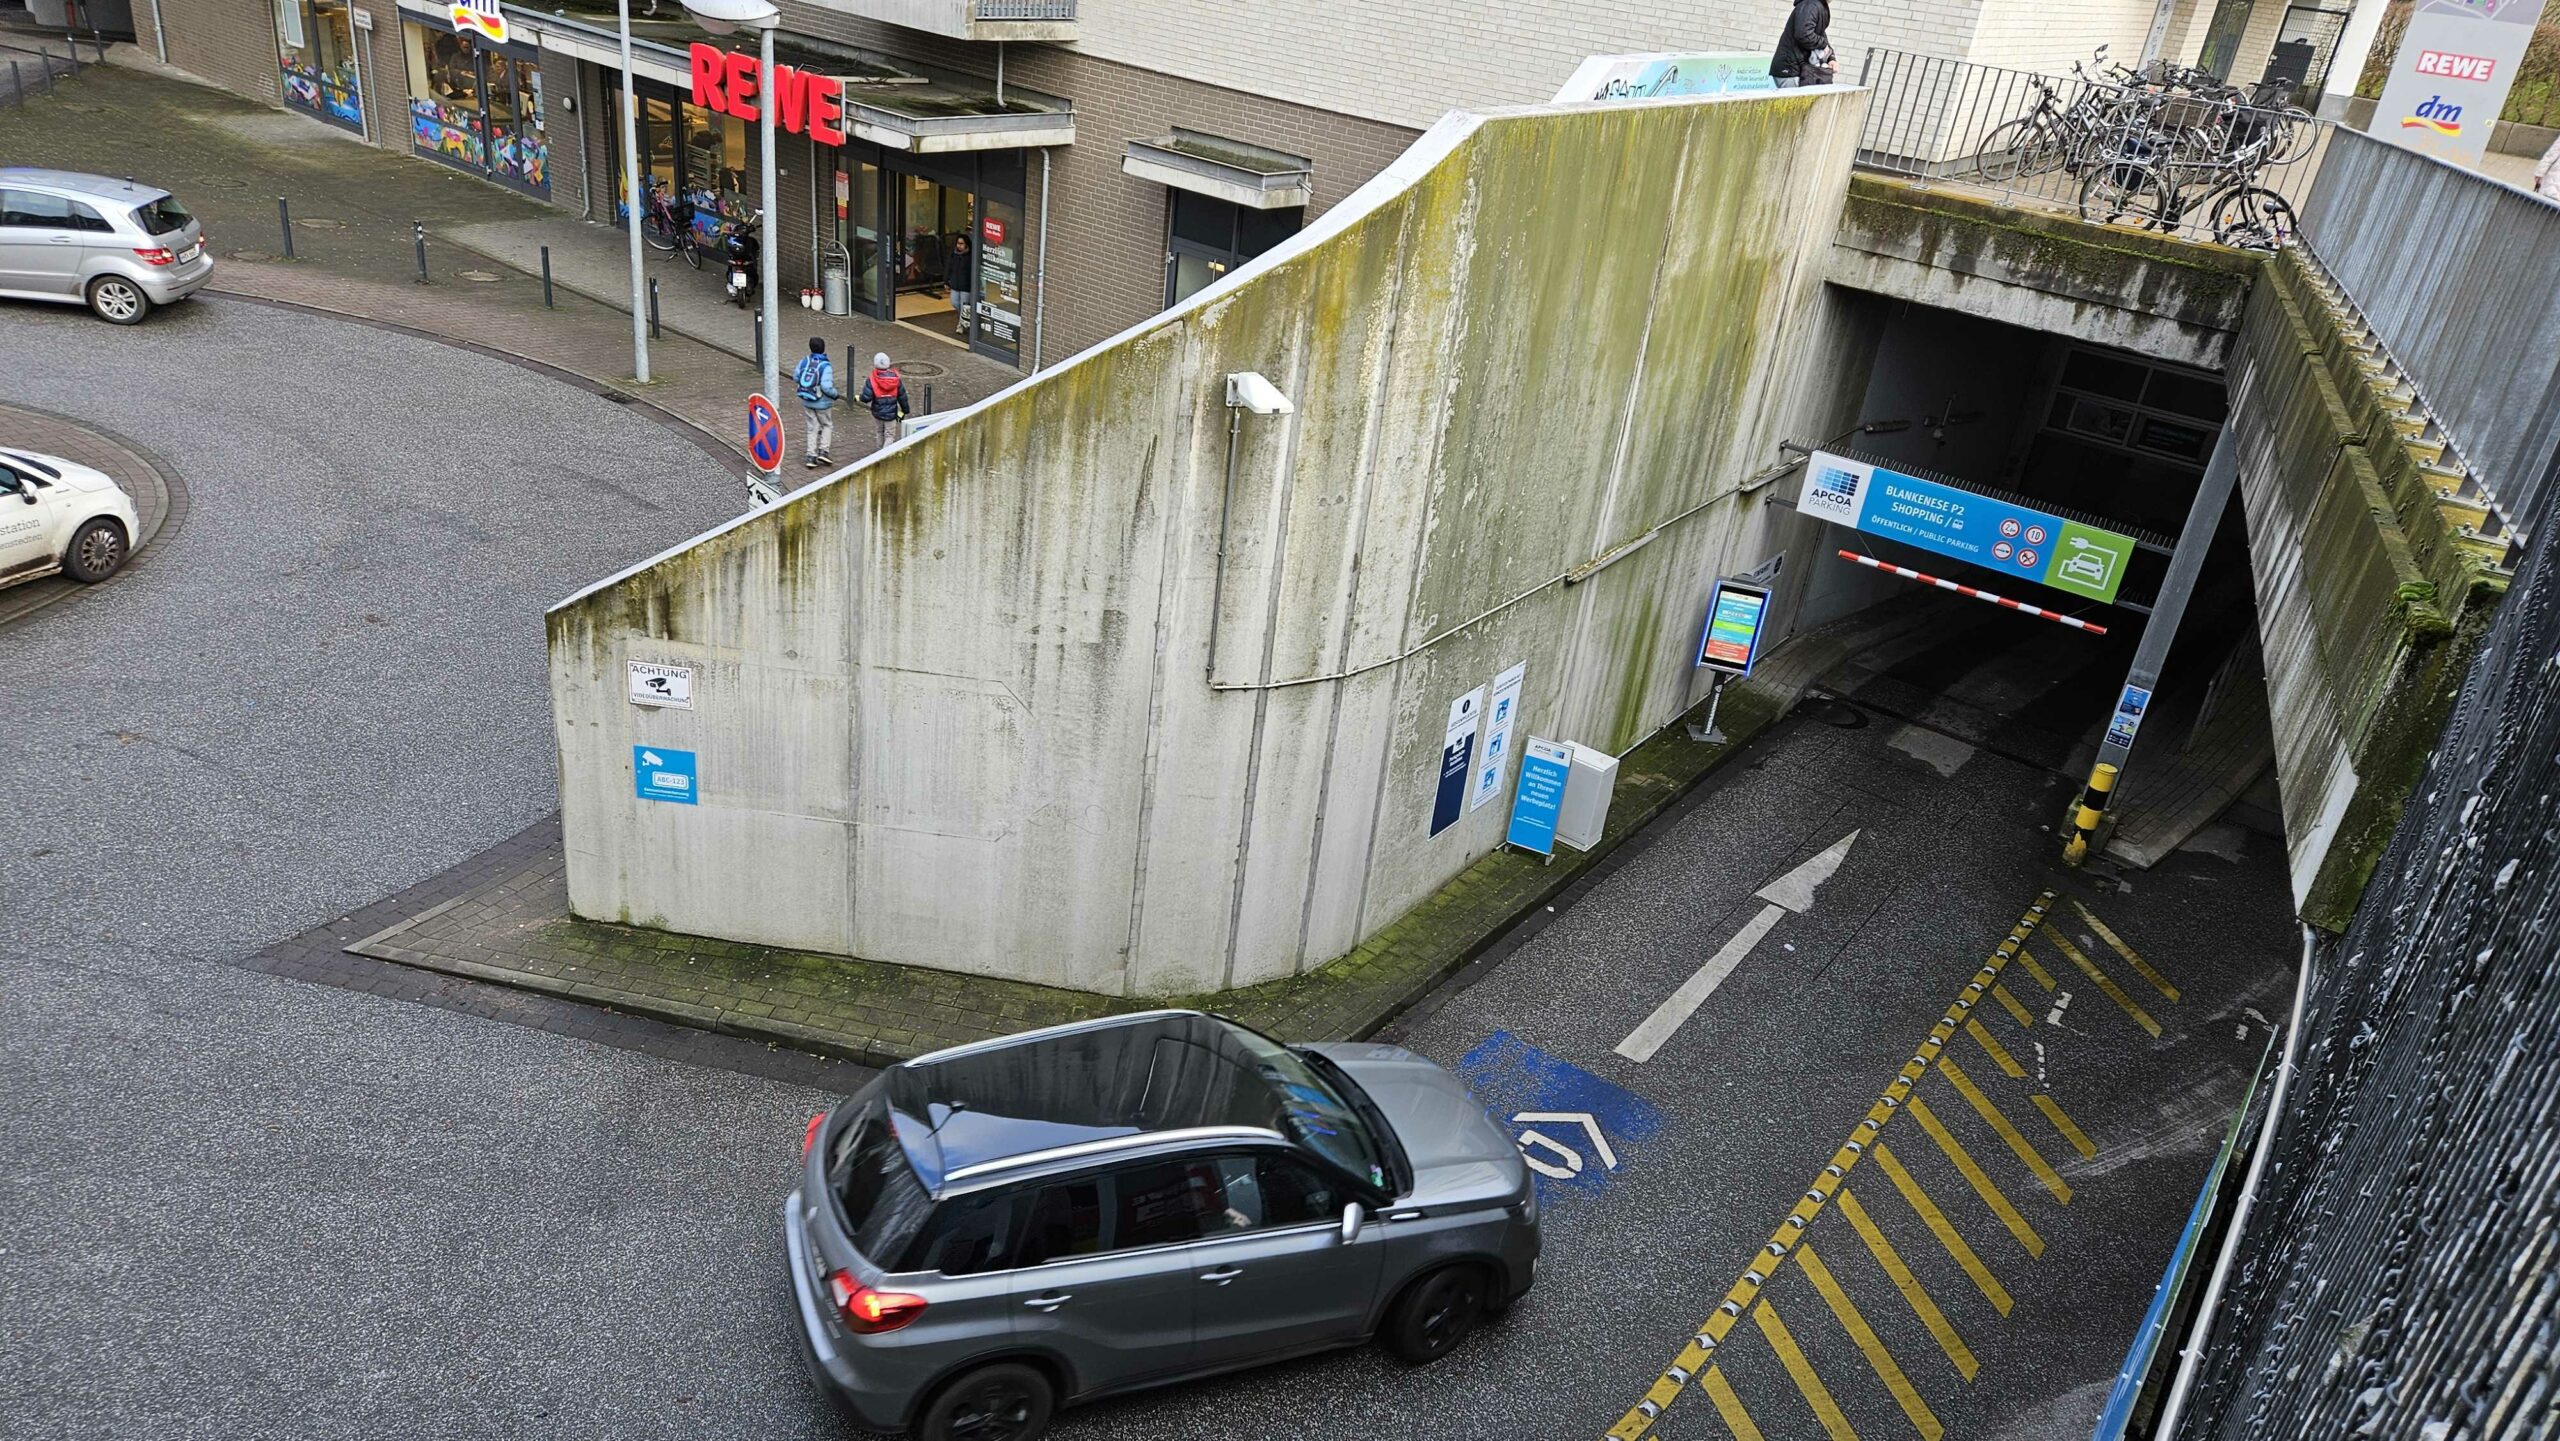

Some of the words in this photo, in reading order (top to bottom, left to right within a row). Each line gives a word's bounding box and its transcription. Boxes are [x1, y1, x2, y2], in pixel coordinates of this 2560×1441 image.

[2417, 52, 2494, 80] REWE
[690, 42, 846, 147] REWE
[2415, 95, 2463, 122] dm
[1808, 497, 1850, 516] PARKING
[1811, 488, 1852, 507] APCOA
[1885, 485, 1948, 512] BLANKENESE
[1951, 504, 1965, 516] P2
[1891, 501, 1944, 525] SHOPPING
[1871, 514, 1913, 534] ÖFFENTLICH
[1919, 529, 1946, 543] PUBLIC
[1946, 537, 1980, 553] PARKING
[2031, 530, 2041, 540] 10
[632, 665, 687, 679] ACHTUNG
[656, 776, 685, 785] ABC-123
[1525, 772, 1562, 787] Willkommen
[1532, 765, 1557, 777] Herzlich
[1530, 790, 1550, 800] neuen
[1537, 783, 1555, 793] Ihrem
